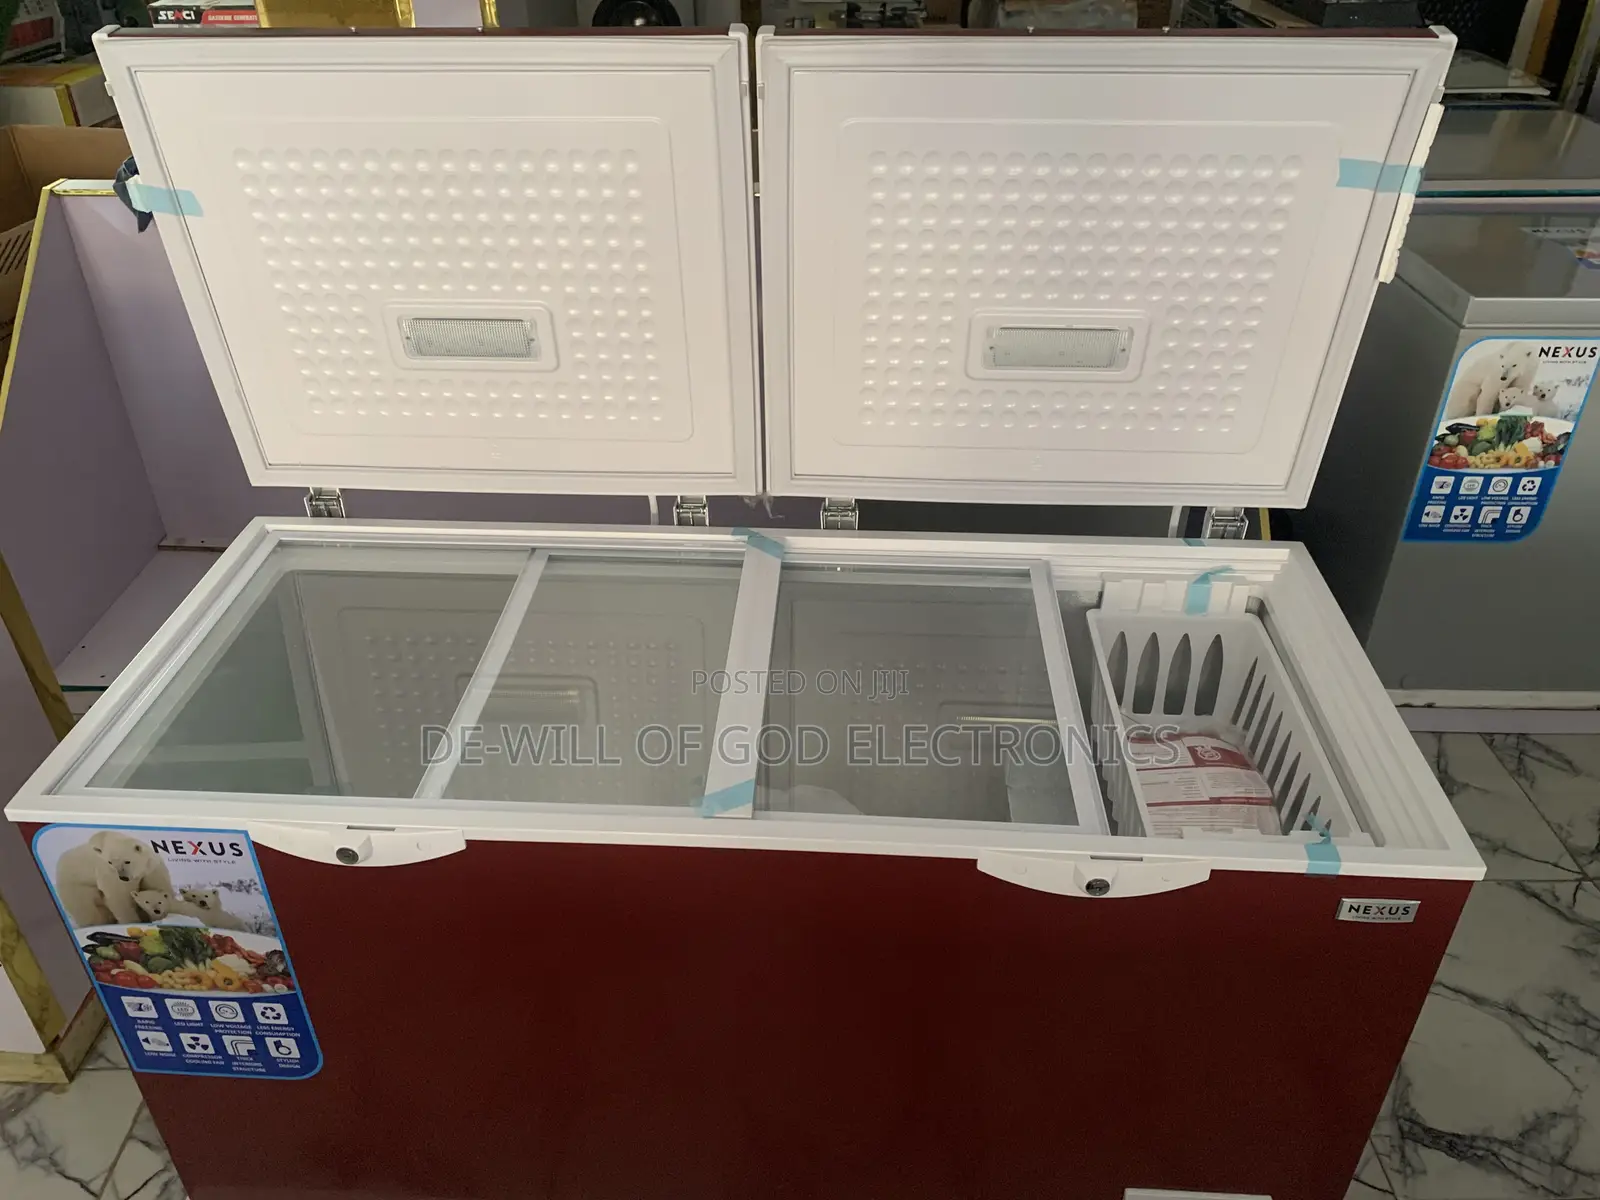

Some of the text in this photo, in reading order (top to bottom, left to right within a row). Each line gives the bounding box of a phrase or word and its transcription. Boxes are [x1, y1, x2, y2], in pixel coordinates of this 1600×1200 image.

[1538, 346, 1598, 358] NEXUS
[150, 839, 244, 857] NEXUS
[1348, 904, 1411, 915] NEXUS
